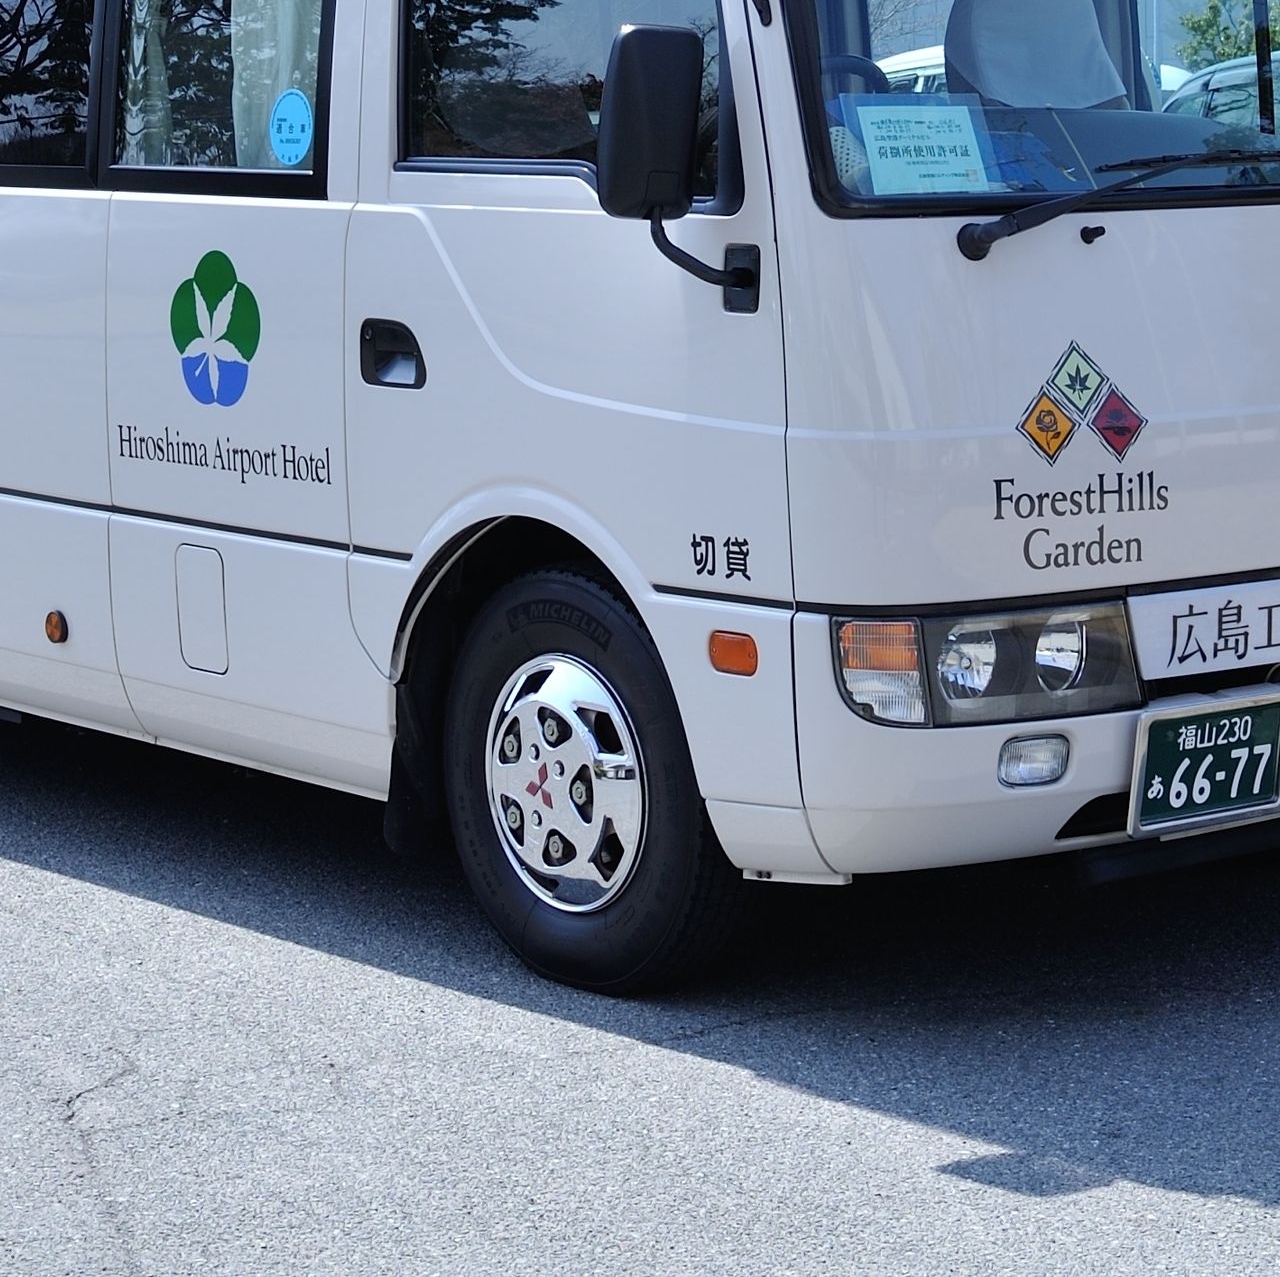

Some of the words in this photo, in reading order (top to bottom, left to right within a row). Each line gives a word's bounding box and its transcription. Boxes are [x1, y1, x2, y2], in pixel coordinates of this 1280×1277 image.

[118, 424, 209, 468] Hiroshima
[213, 436, 278, 484] Airport
[281, 444, 332, 485] Hotel
[993, 470, 1169, 520] ForestHills
[1023, 524, 1143, 570] Garden
[529, 603, 609, 644] MICHELIN
[1170, 744, 1272, 808] 66-77
